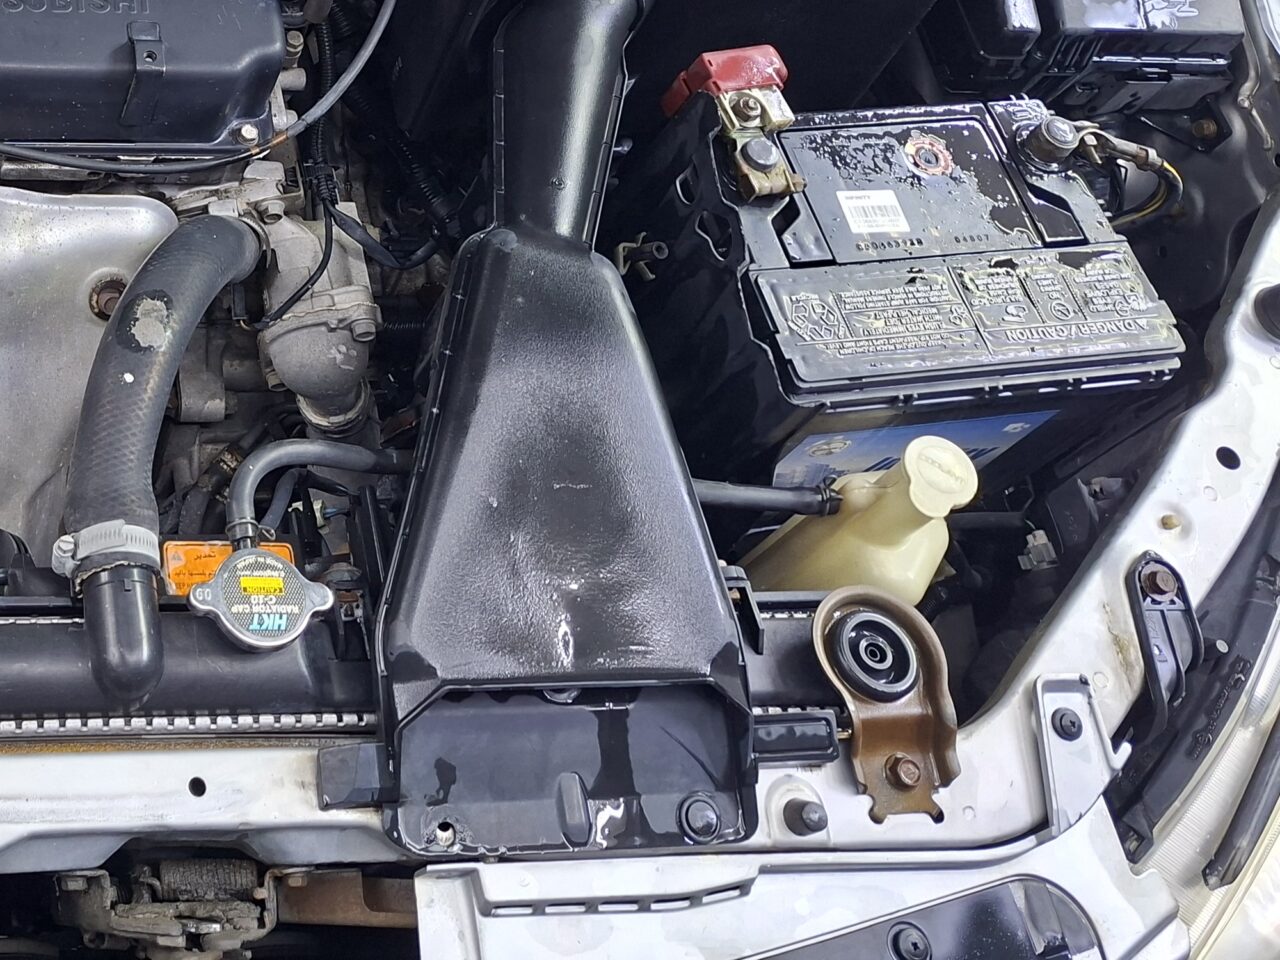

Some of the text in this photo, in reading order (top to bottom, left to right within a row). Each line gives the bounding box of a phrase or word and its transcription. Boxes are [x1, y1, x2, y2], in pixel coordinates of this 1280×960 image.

[862, 325, 907, 335] IMMEDIATELY
[1004, 325, 1067, 341] CAUTION
[1077, 319, 1136, 334] DANGER
[230, 603, 300, 614] RADIATOR CAP
[248, 613, 288, 631] HKT
